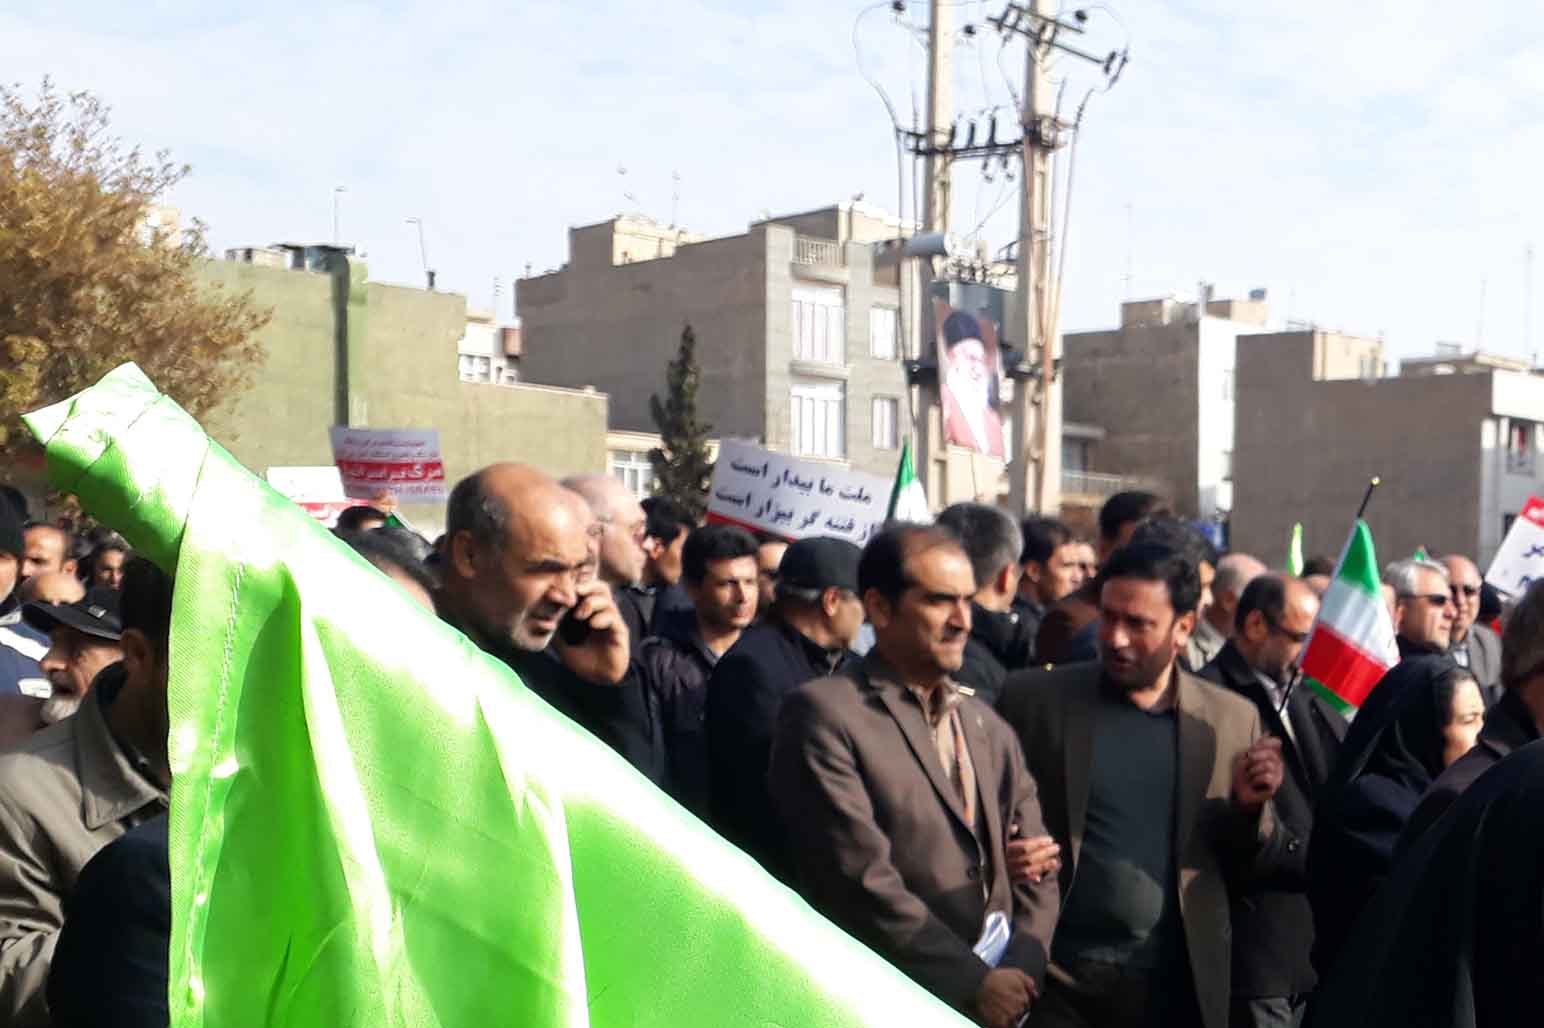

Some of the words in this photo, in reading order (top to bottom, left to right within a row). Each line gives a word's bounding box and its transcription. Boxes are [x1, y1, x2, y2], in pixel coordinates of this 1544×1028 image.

[730, 461, 769, 478] است
[771, 469, 814, 497] بیدار
[819, 479, 833, 496] ما
[715, 489, 752, 508] است
[838, 487, 872, 504] ملت
[755, 499, 794, 526] بیزار
